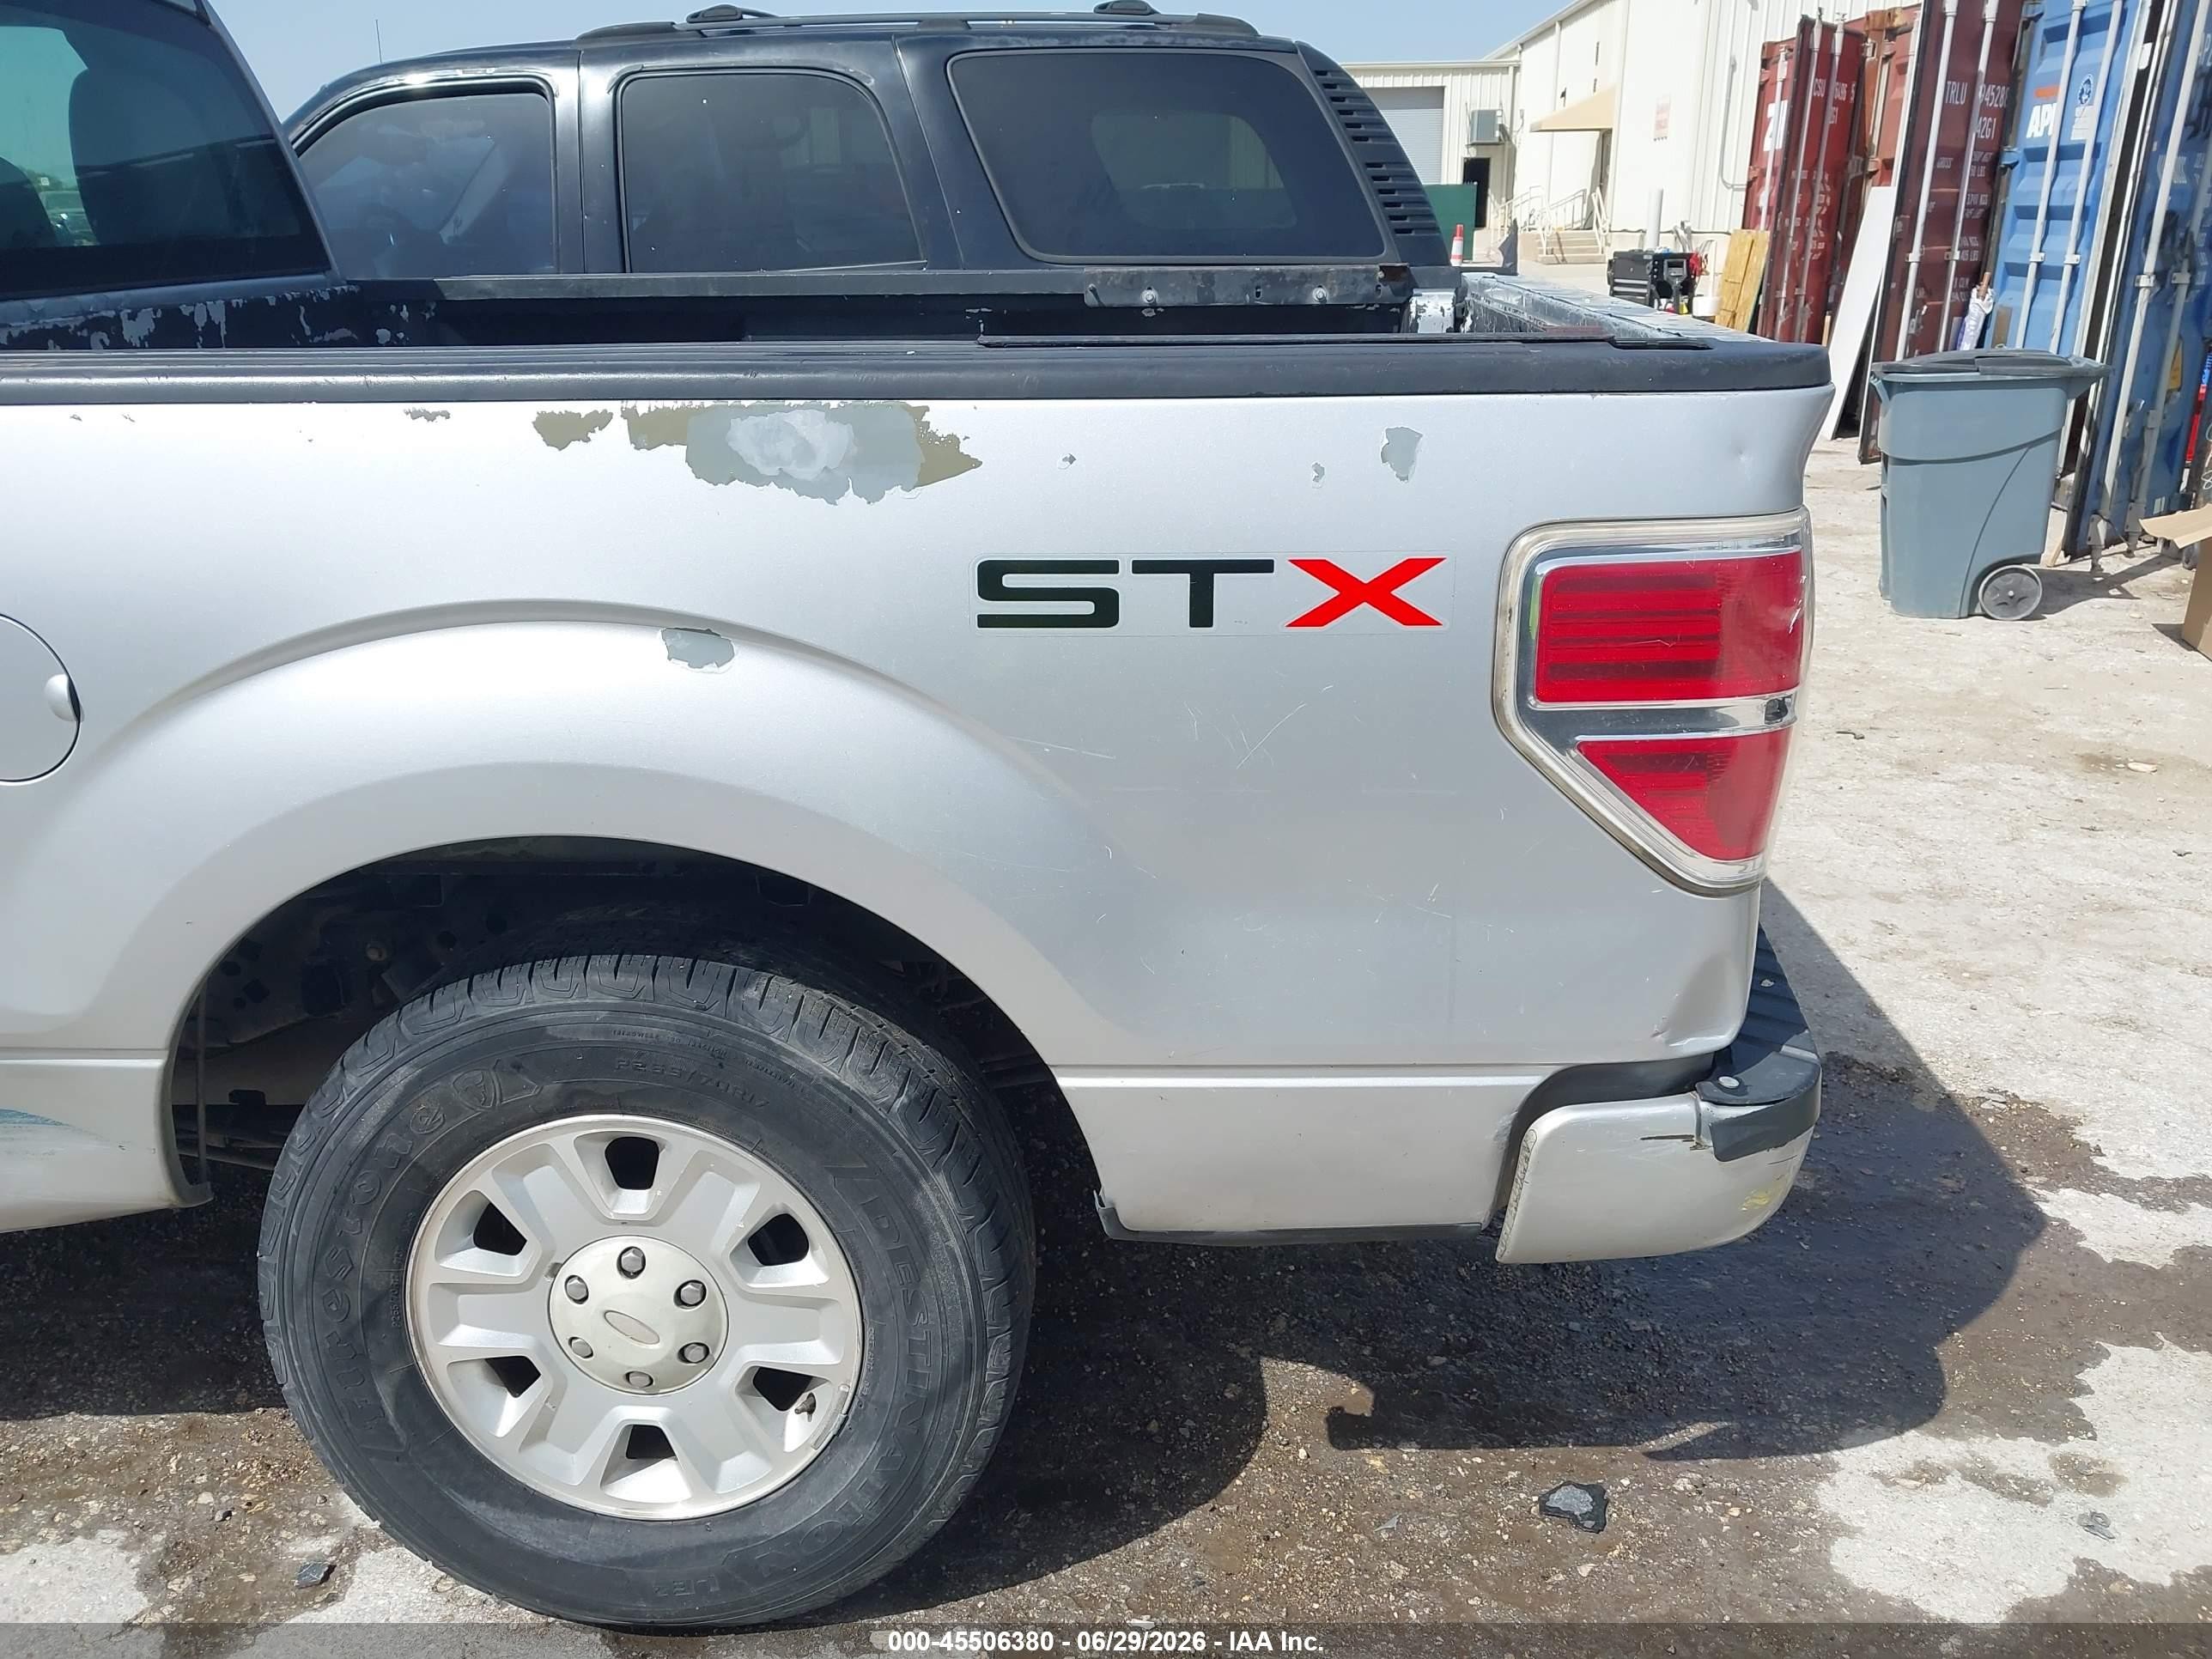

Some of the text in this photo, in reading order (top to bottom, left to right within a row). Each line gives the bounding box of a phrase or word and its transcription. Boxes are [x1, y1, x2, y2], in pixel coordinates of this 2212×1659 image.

[1945, 80, 1968, 105] TRLU
[976, 557, 1446, 629] STX
[321, 1101, 446, 1432] Firestone
